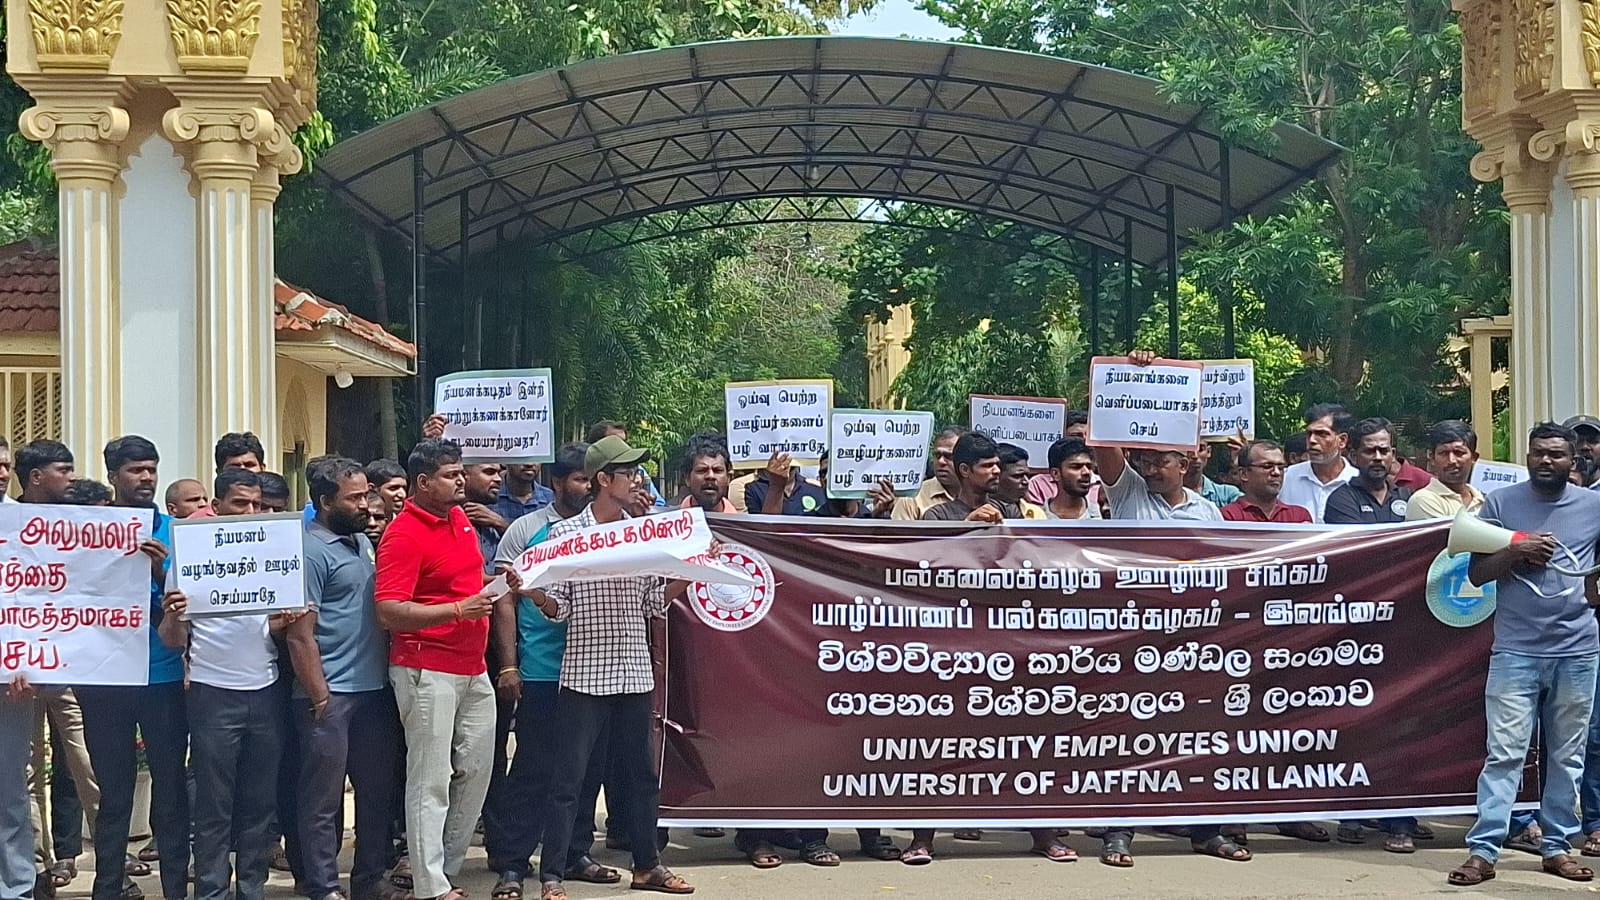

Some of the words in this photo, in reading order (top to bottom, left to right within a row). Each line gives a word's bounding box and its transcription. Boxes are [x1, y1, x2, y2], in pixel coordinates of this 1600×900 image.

[1105, 368, 1189, 385] நியமனங்களை
[1202, 369, 1246, 385] யர்விலும்
[518, 381, 545, 400] இன்றி
[737, 391, 770, 409] ஓய்வு
[778, 389, 817, 406] பெற்ற
[982, 402, 1055, 420] நியமனங்களை
[1095, 394, 1198, 412] வெளிப்படையாகச்
[733, 414, 824, 433] ஊழியர்களைப்
[843, 419, 876, 437] ஓய்வு
[884, 419, 920, 436] பெற்ற
[1129, 421, 1158, 436] செய்
[732, 440, 751, 458] பழி
[837, 444, 923, 463] ஊழியர்களைப்
[834, 469, 854, 488] பழி
[20, 517, 143, 556] அலுவலர்
[215, 526, 267, 548] நியமனம்
[181, 556, 257, 581] வழங்குவதில்
[265, 554, 300, 576] ஊழல்
[885, 560, 1101, 594] பல்கலைக்கழக
[1245, 556, 1328, 587] சங்கம்
[209, 587, 276, 605] செய்யாதே
[812, 596, 973, 631] யாழ்ப்பாணப்
[988, 599, 1221, 634] பல்கலைக்கழகம்
[1264, 594, 1394, 626] இலங்கை
[1134, 642, 1251, 678] මණ්ඩල
[1263, 639, 1384, 670] සංගමය
[826, 691, 954, 716] යාපනය
[1262, 678, 1374, 714] ලංකාව
[863, 735, 1046, 761] UNIVERSITY
[1054, 730, 1230, 758] EMPLOYEES
[1236, 728, 1338, 754] UNION
[822, 772, 1007, 797] UNIVERSITY
[1013, 771, 1055, 795] OF
[1062, 769, 1183, 795] JAFFNA
[1213, 767, 1260, 791] SRI
[1267, 762, 1371, 789] LANKA
